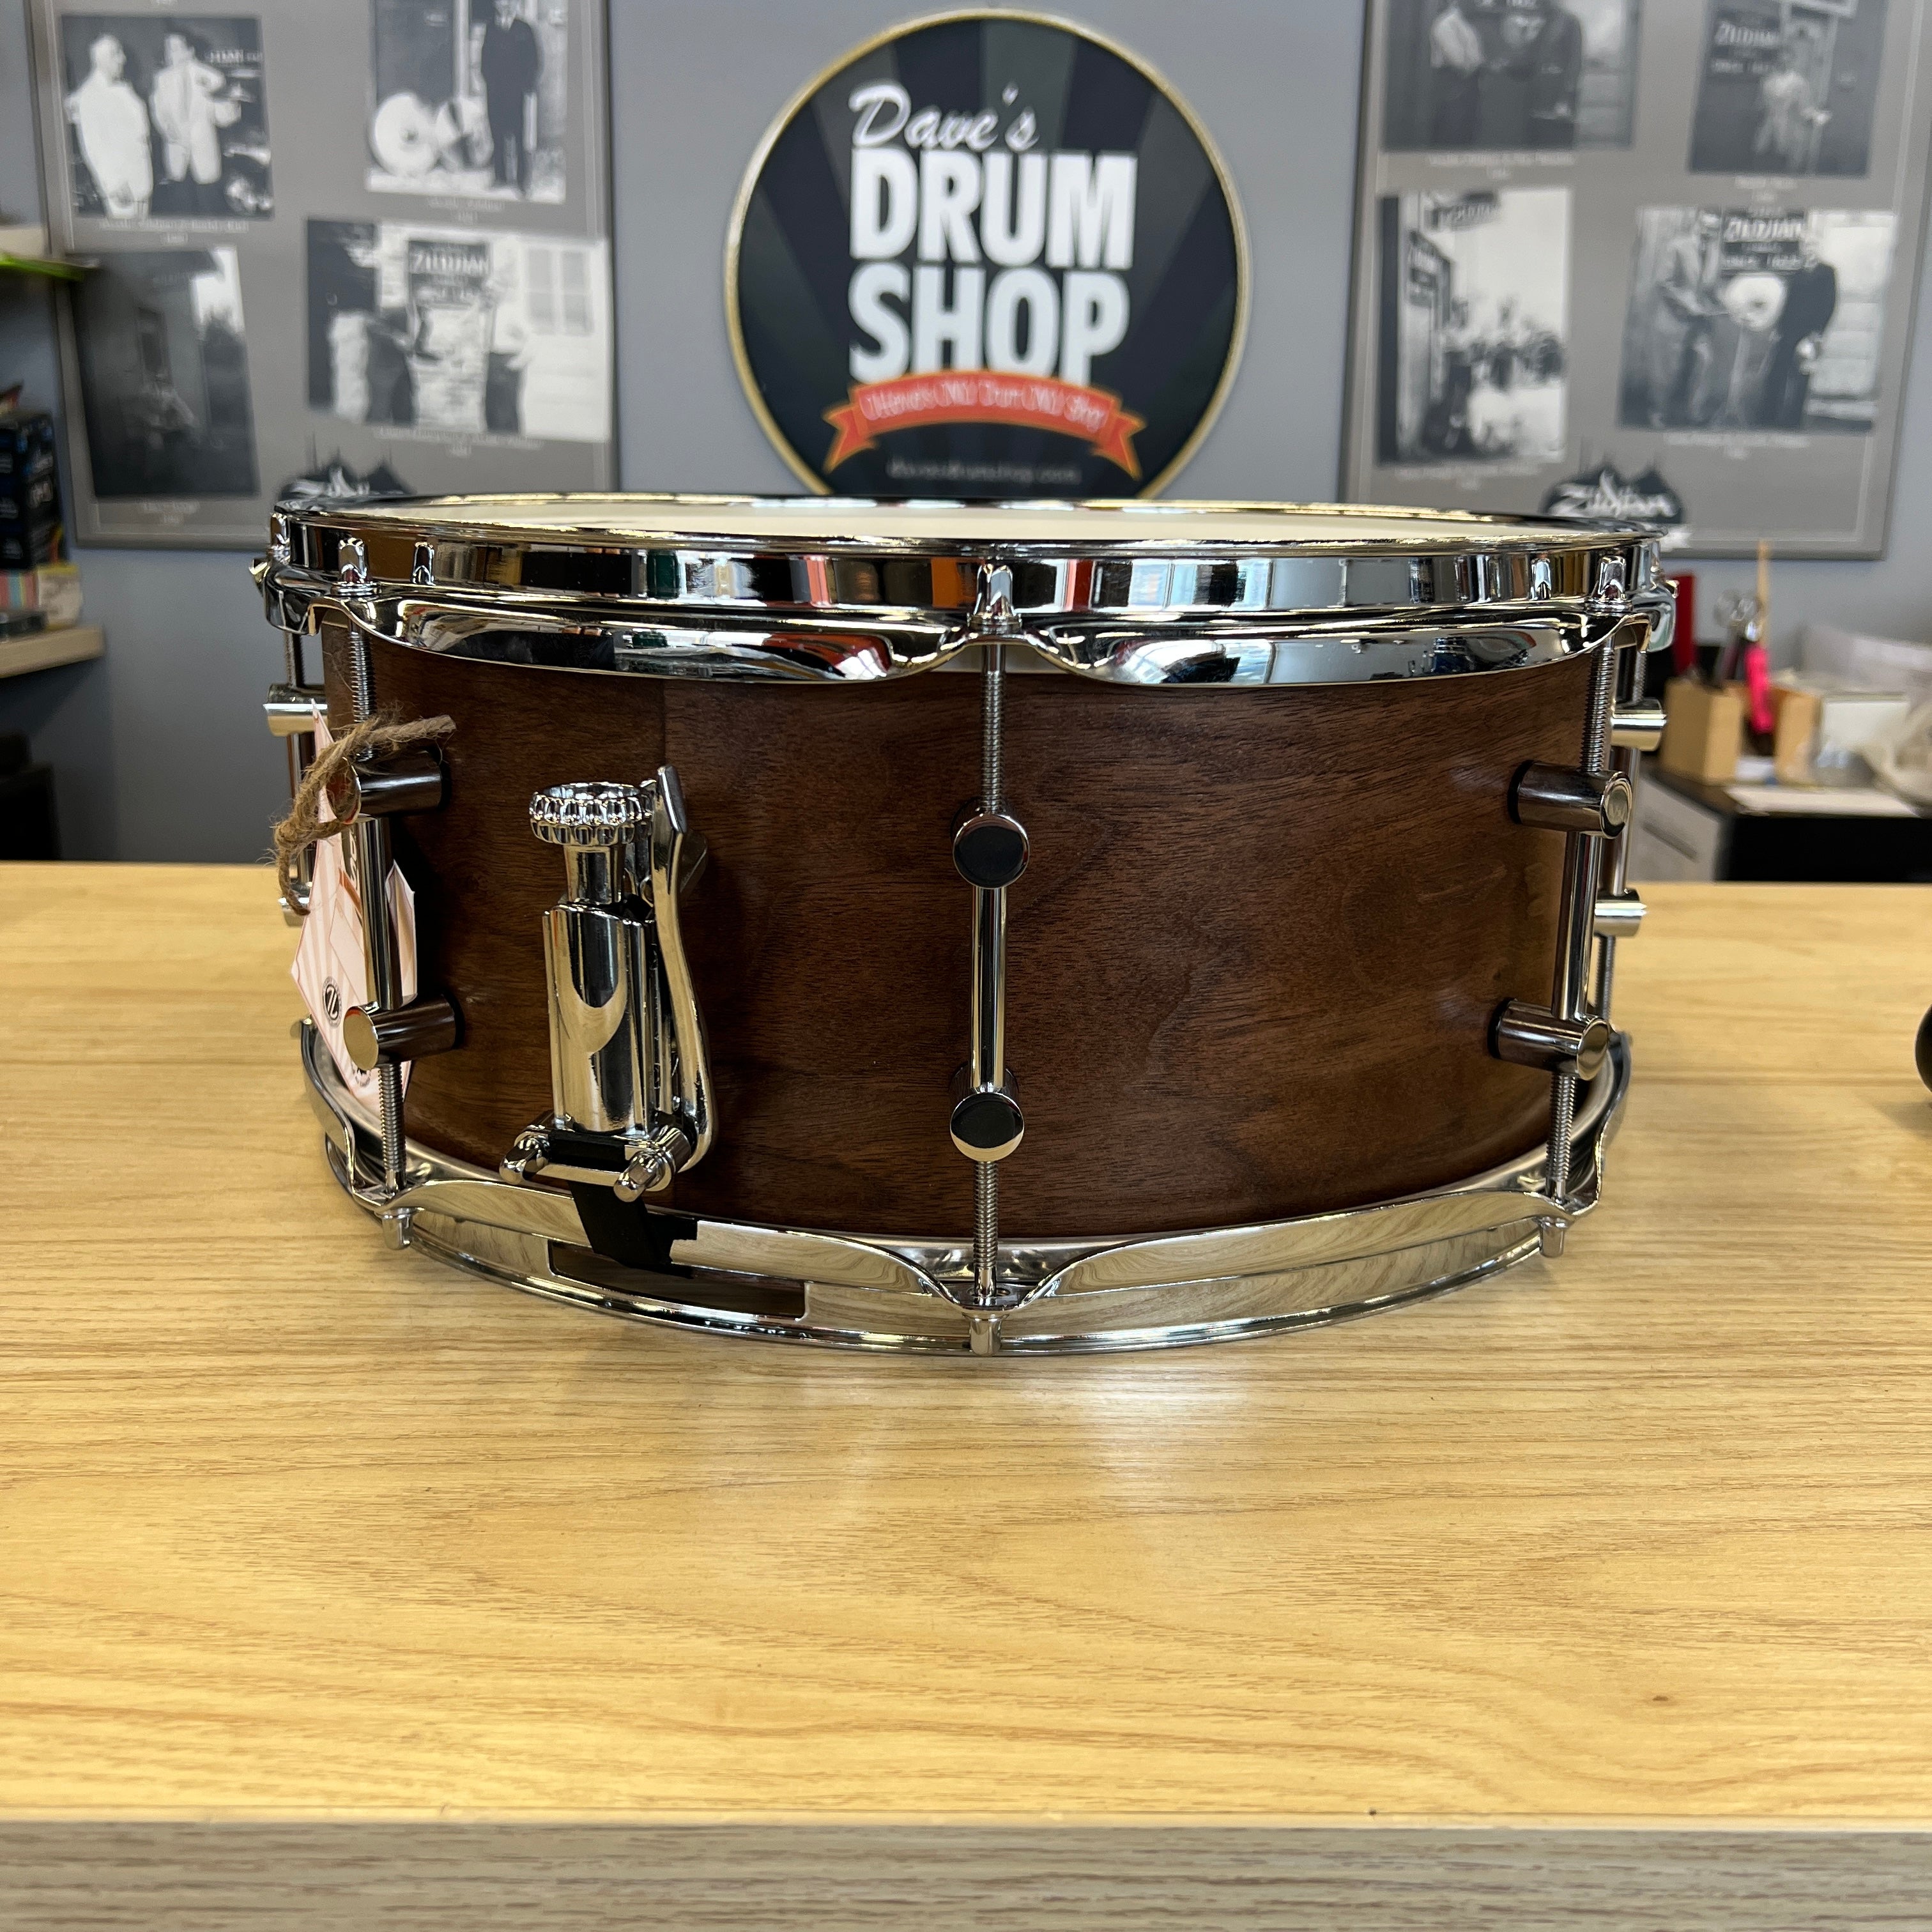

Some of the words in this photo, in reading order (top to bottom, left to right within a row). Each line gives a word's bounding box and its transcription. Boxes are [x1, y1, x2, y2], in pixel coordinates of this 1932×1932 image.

[848, 80, 1040, 150] Dave's
[850, 148, 1138, 270] DRUM
[848, 263, 1130, 386] SHOP
